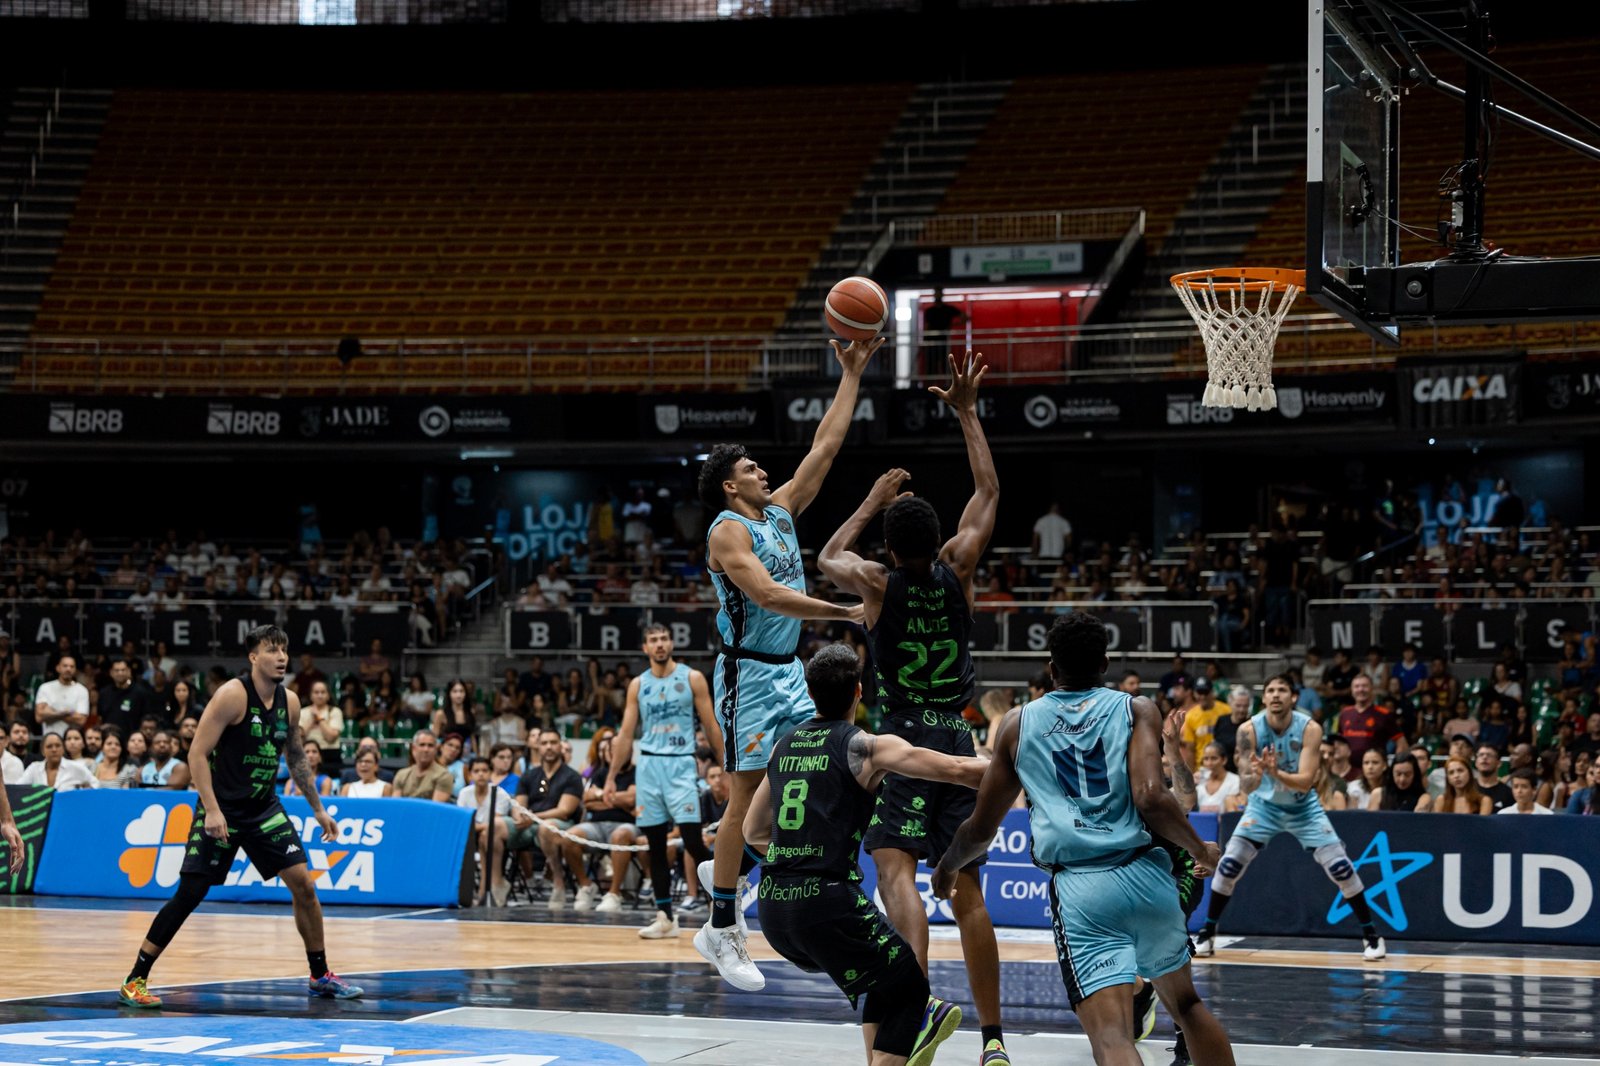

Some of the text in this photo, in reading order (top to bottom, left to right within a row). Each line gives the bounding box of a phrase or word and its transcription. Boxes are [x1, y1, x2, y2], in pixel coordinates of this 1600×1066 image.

[1303, 388, 1385, 408] Heavenly
[1412, 374, 1507, 404] CAIXA
[75, 409, 123, 433] BRB
[325, 406, 389, 426] JADE
[681, 407, 756, 425] Heavenly
[785, 397, 874, 422] CAA
[1191, 401, 1234, 423] BRB
[233, 411, 280, 434] BRB
[528, 621, 691, 651] BRB
[906, 616, 950, 635] ANJOS
[896, 638, 959, 690] 22
[778, 755, 830, 773] VITHINHO
[777, 778, 809, 831] 8
[986, 826, 1027, 854] ÃO
[999, 880, 1049, 900] COM
